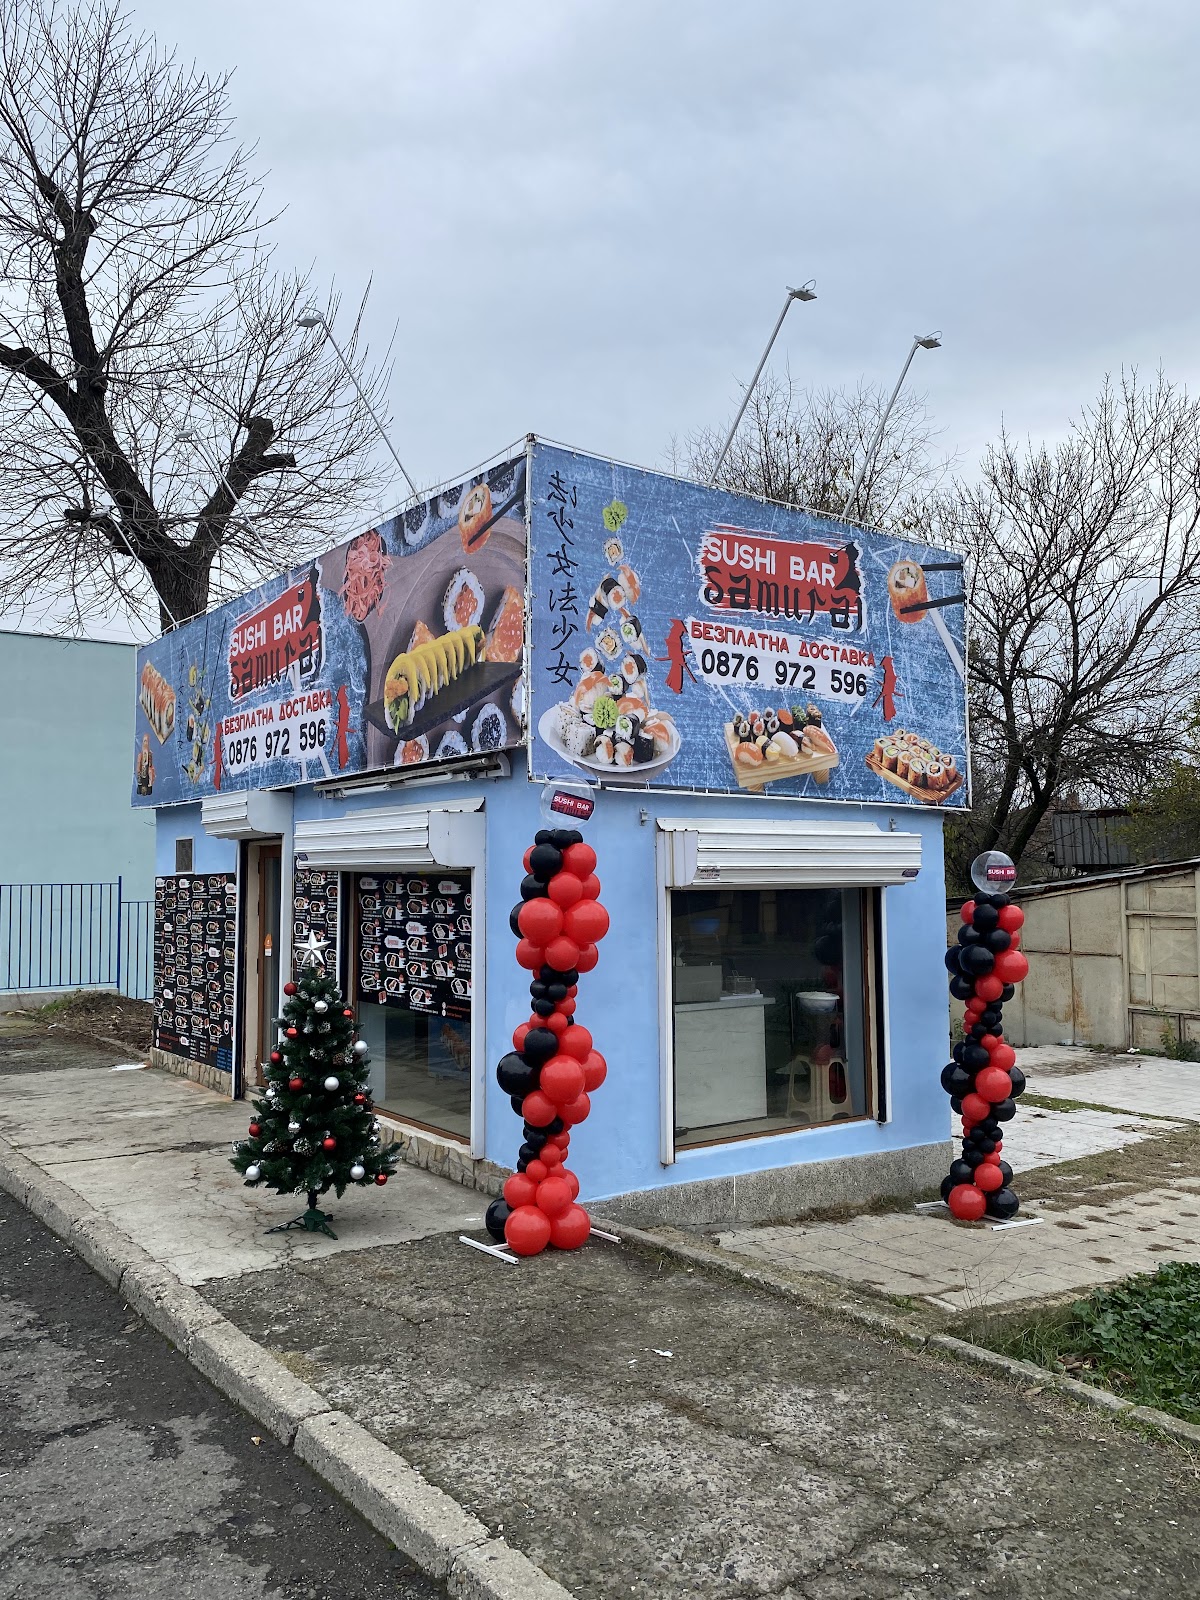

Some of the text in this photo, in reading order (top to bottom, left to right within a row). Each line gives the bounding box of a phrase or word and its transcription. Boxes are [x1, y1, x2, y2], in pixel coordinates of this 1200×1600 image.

[704, 536, 836, 588] SUSHI BAR
[230, 604, 303, 657] SUSHI BAR
[691, 621, 876, 668] БЕЗПЛАТНА ДОСТАВКА
[701, 648, 867, 697] 0876 972 596
[224, 689, 333, 736] БЕЗПЛАТНА ДОСТАВКА
[228, 718, 326, 766] 0876 972 596
[553, 795, 575, 807] SUSHI
[576, 802, 590, 811] BAR
